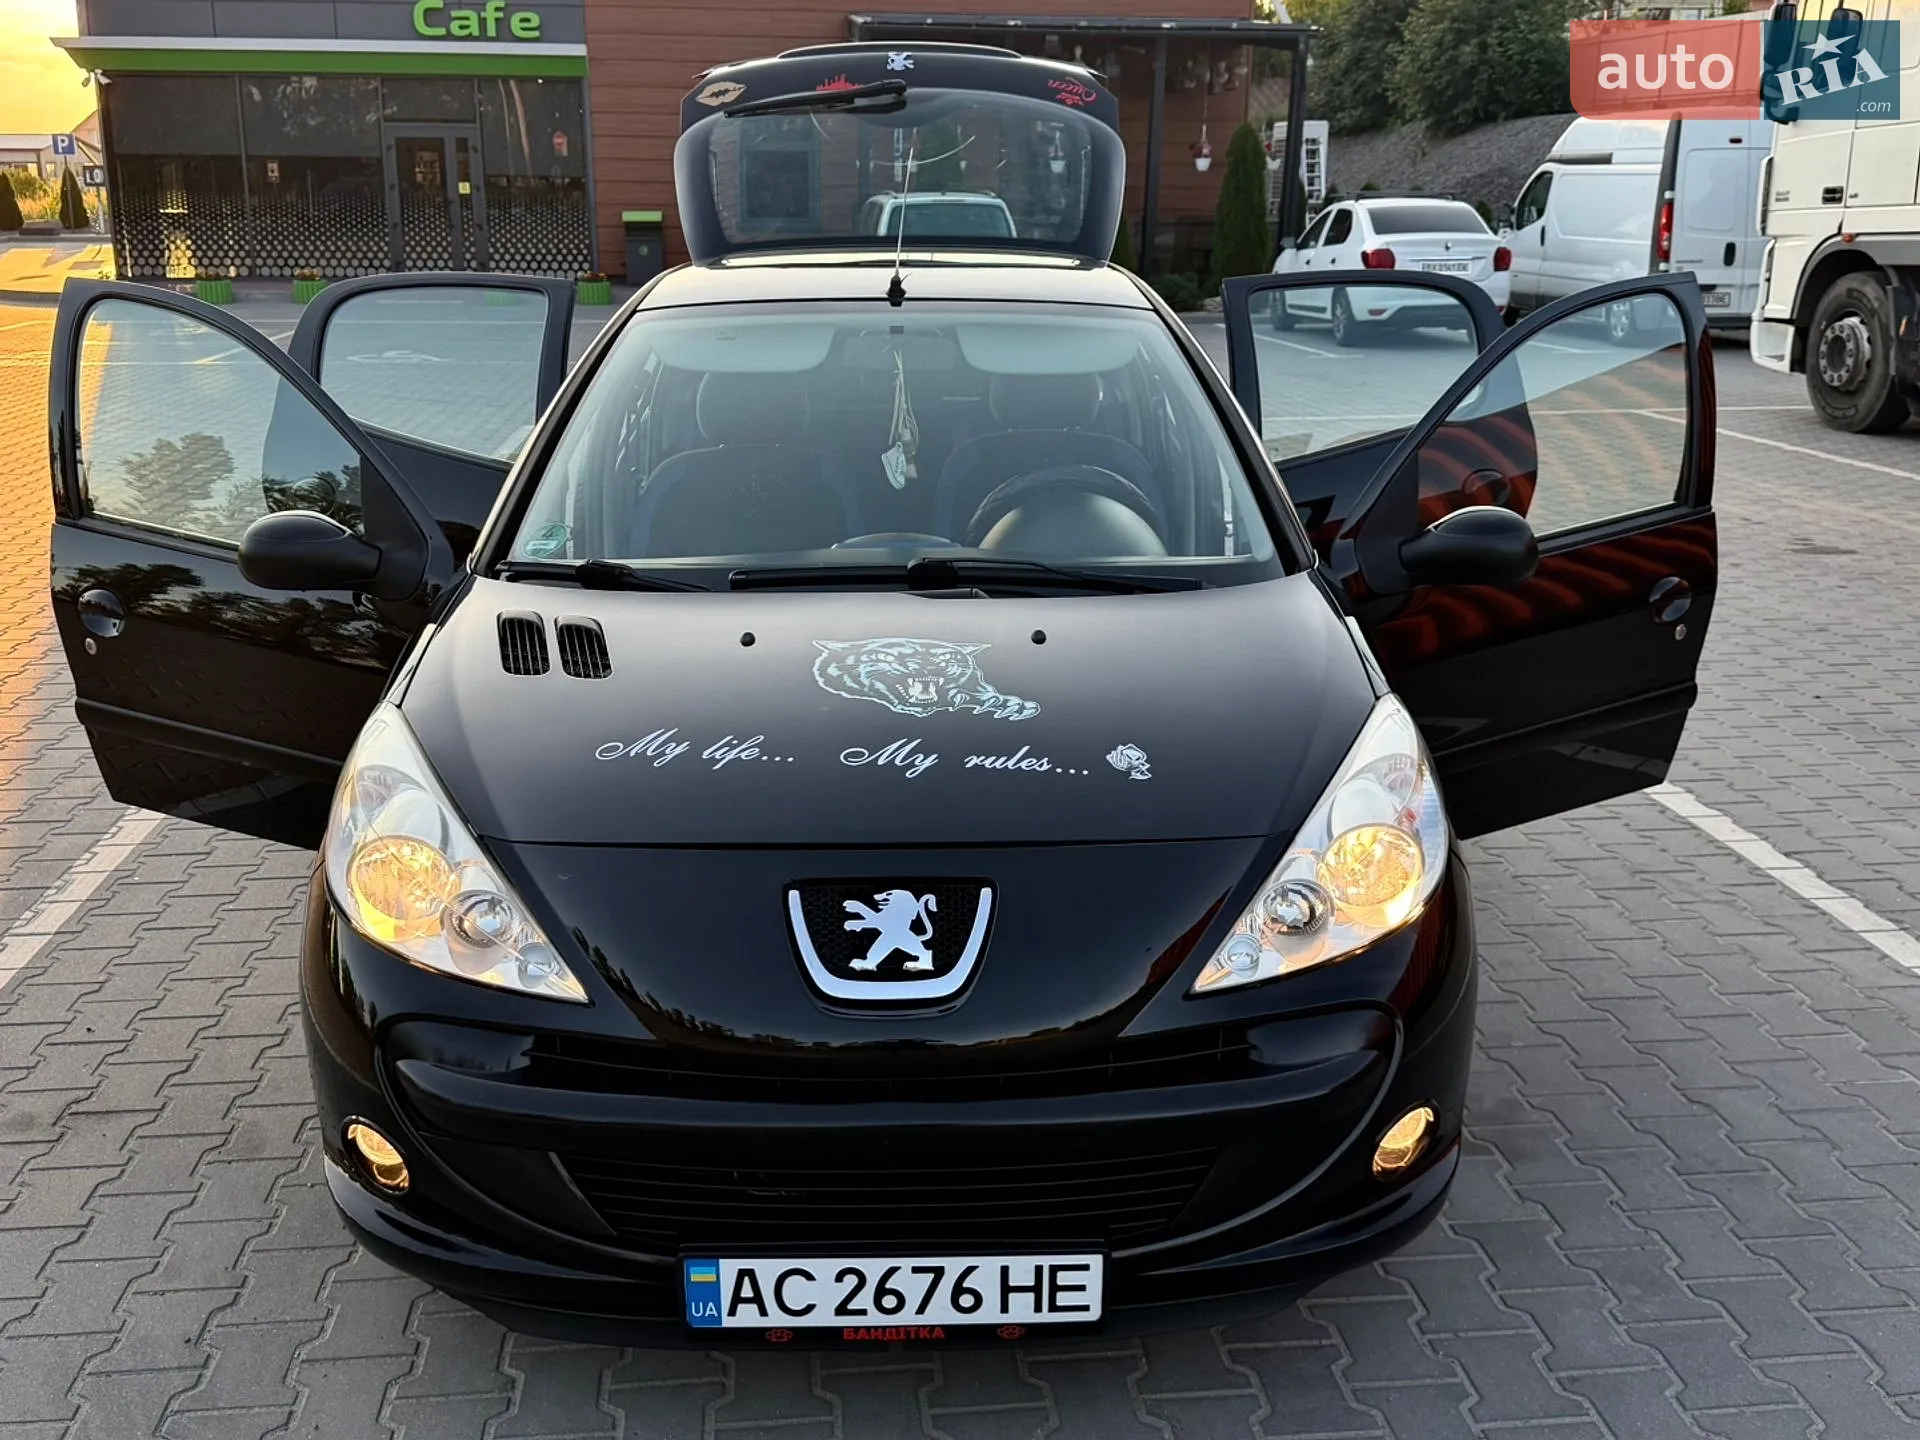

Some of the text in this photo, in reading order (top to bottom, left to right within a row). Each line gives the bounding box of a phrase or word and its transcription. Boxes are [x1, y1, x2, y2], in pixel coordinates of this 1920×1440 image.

[413, 0, 540, 38] Cafe
[57, 136, 69, 153] P
[594, 727, 1089, 778] My life... My rules...
[691, 1263, 1091, 1317] UA AC 2676 HE
